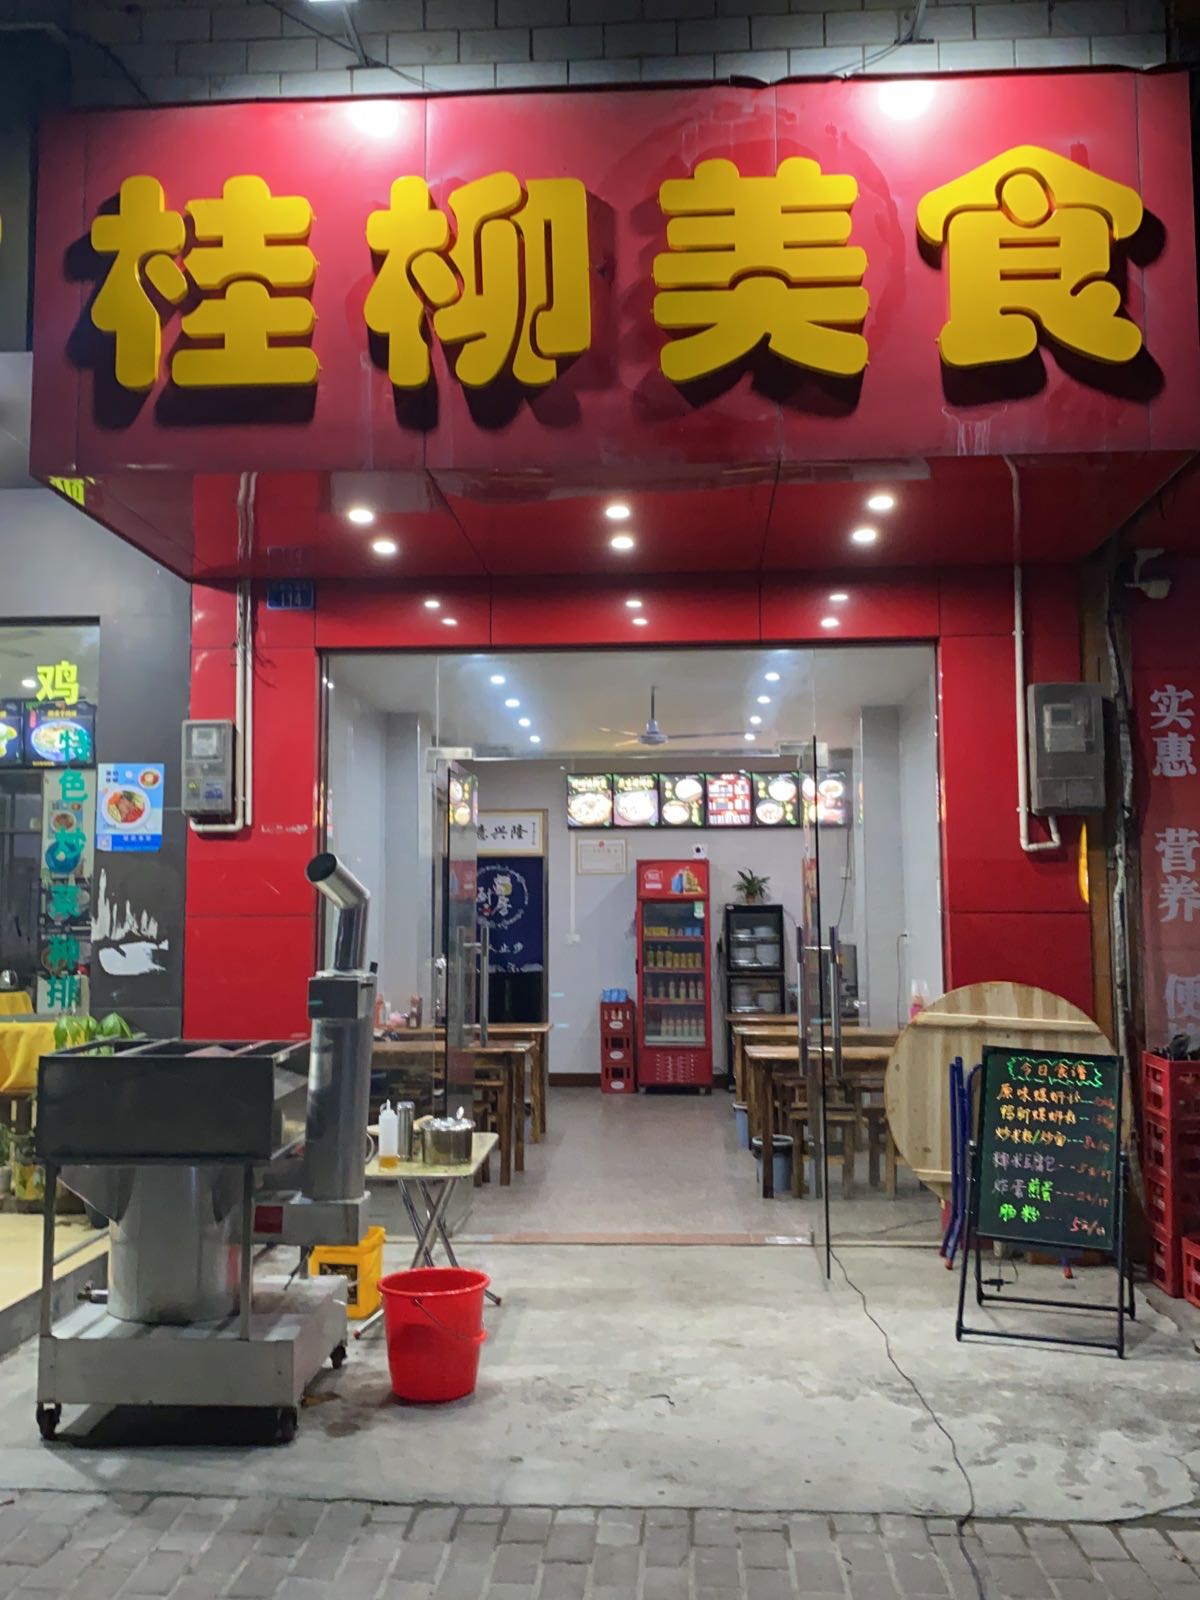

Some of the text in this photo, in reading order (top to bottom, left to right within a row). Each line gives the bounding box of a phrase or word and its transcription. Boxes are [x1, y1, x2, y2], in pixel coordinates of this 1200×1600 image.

[91, 146, 1143, 387] 桂柳美食
[37, 660, 80, 704] 鸡
[1150, 684, 1196, 778] 实惠
[1154, 828, 1200, 923] 营养
